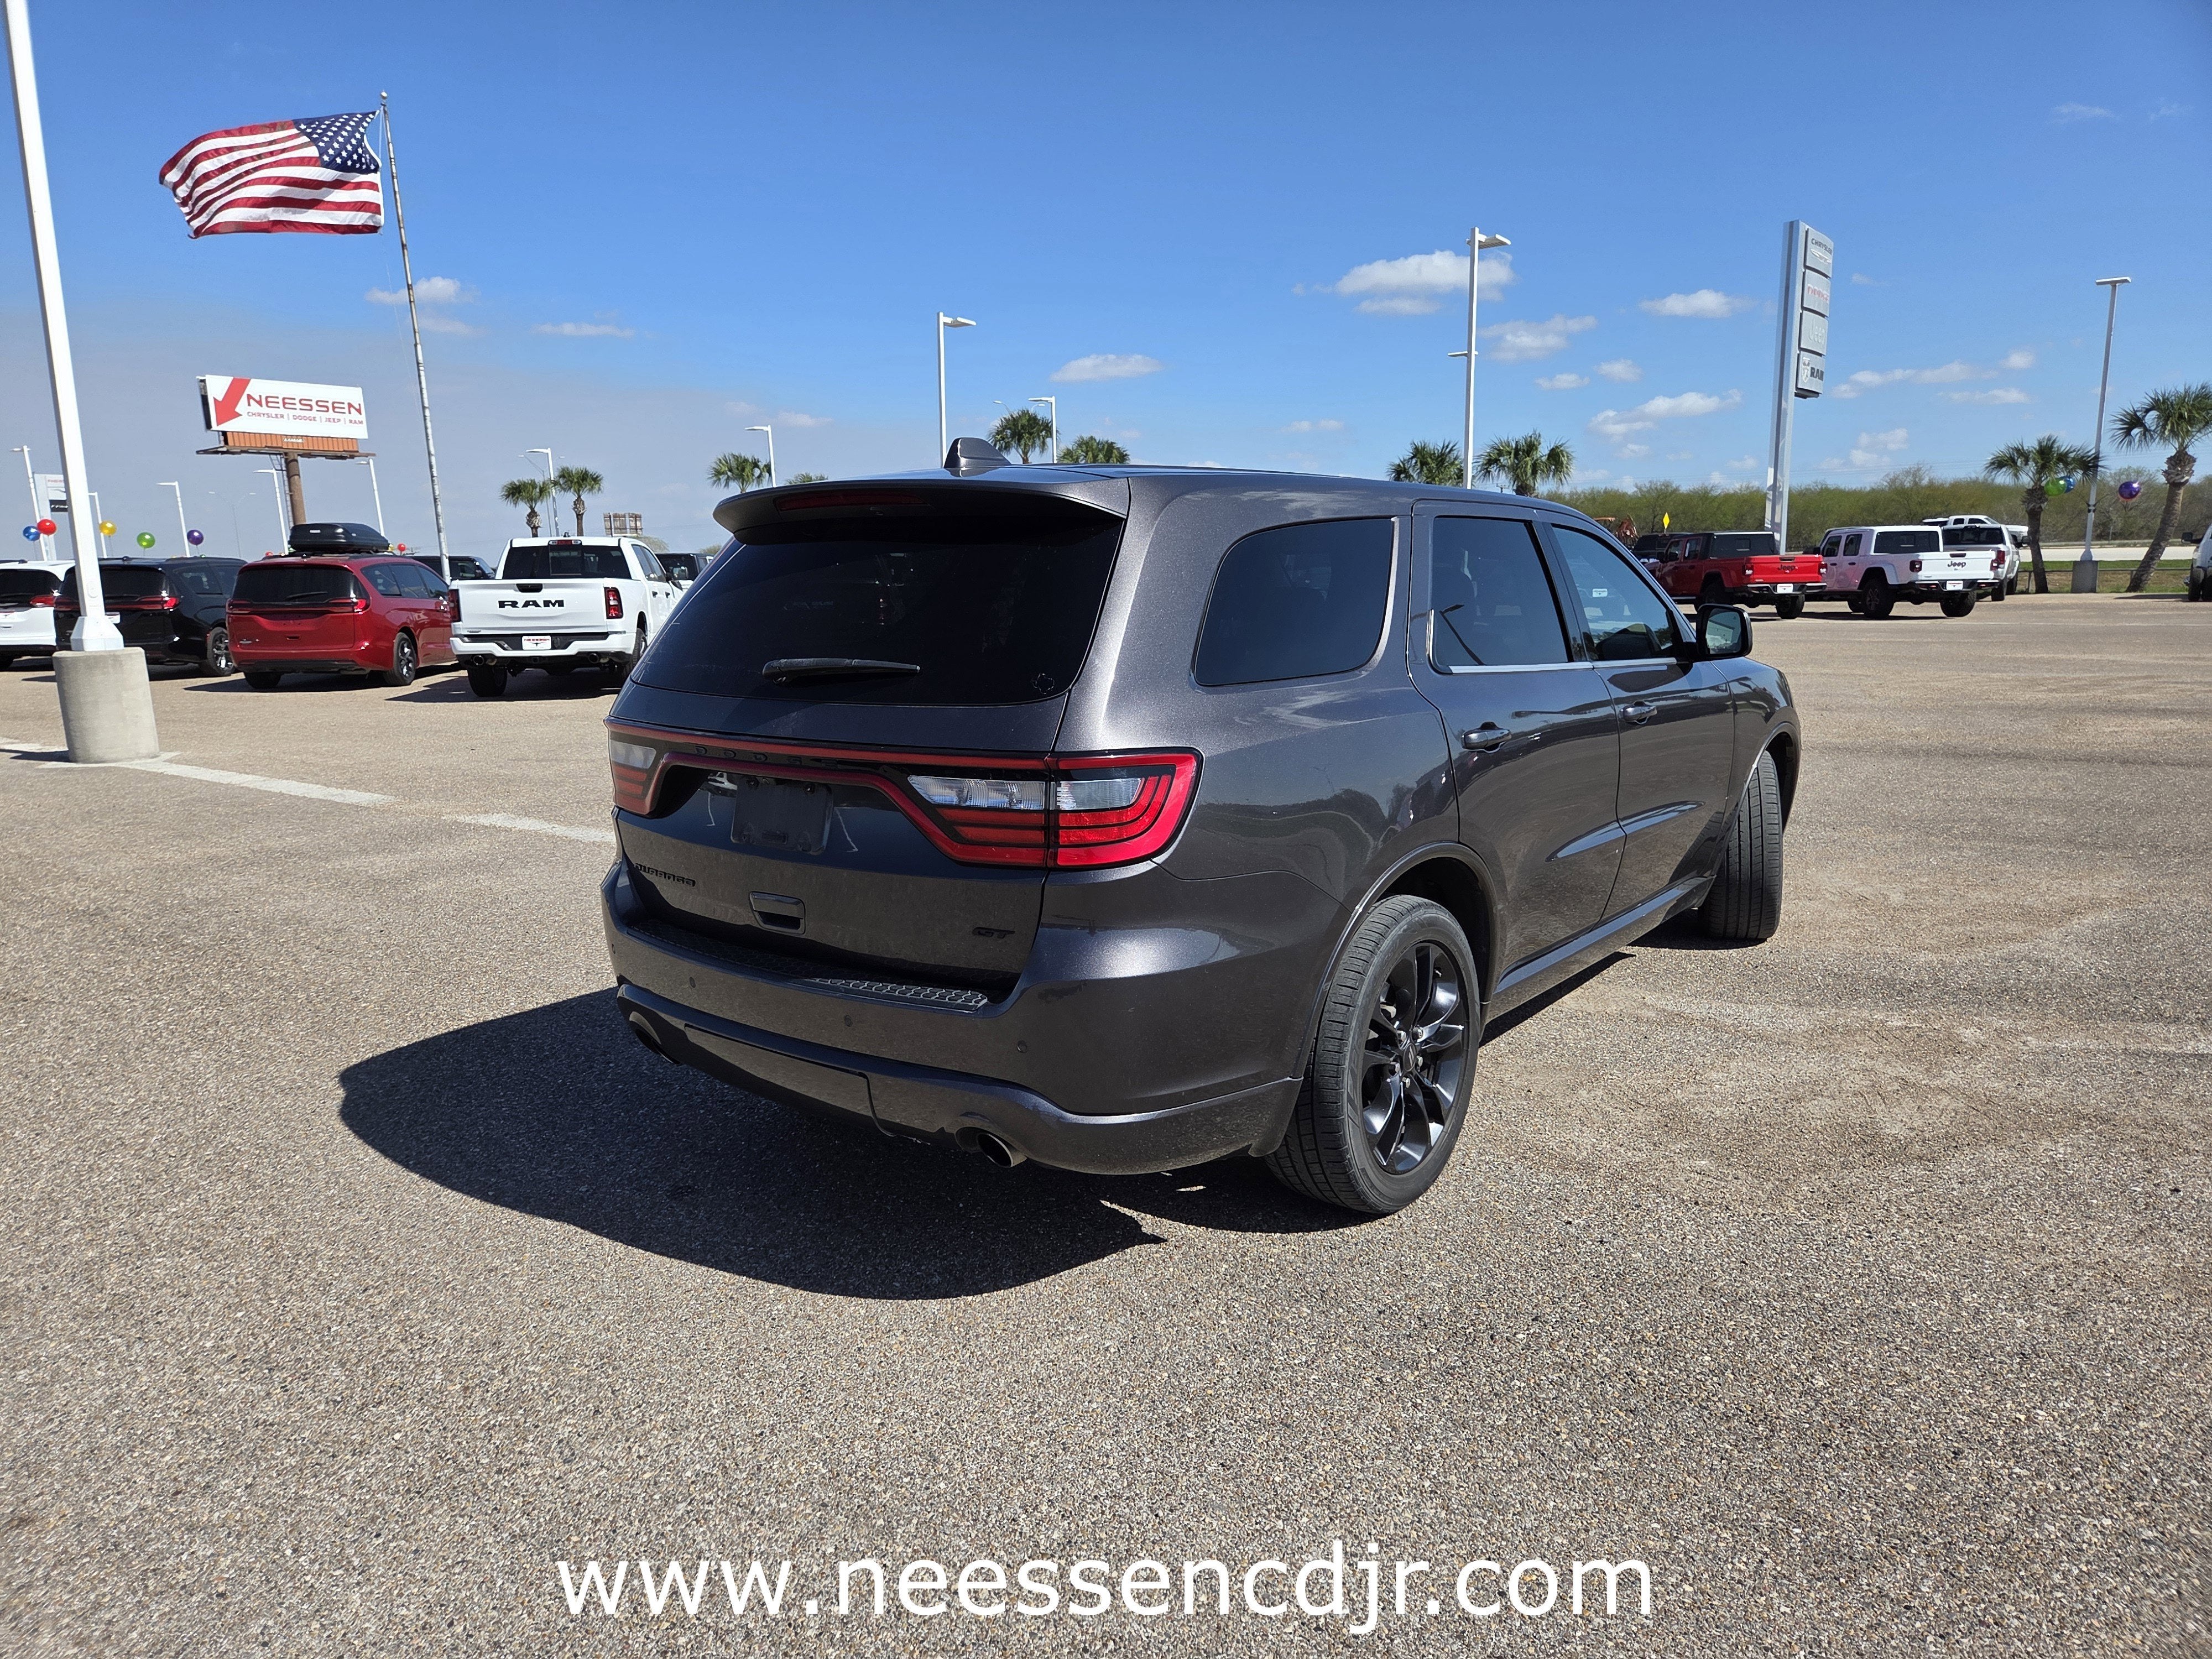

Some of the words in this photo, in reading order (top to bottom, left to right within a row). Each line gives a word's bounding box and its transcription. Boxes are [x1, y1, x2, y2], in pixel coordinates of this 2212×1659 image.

[1811, 238, 1833, 254] CHRYSLER
[1807, 284, 1829, 304] DODGE
[1808, 319, 1825, 345] Jeep
[1810, 366, 1824, 382] RAM
[246, 393, 363, 416] NEESSEN
[498, 599, 565, 608] RAM
[972, 927, 1015, 939] GT
